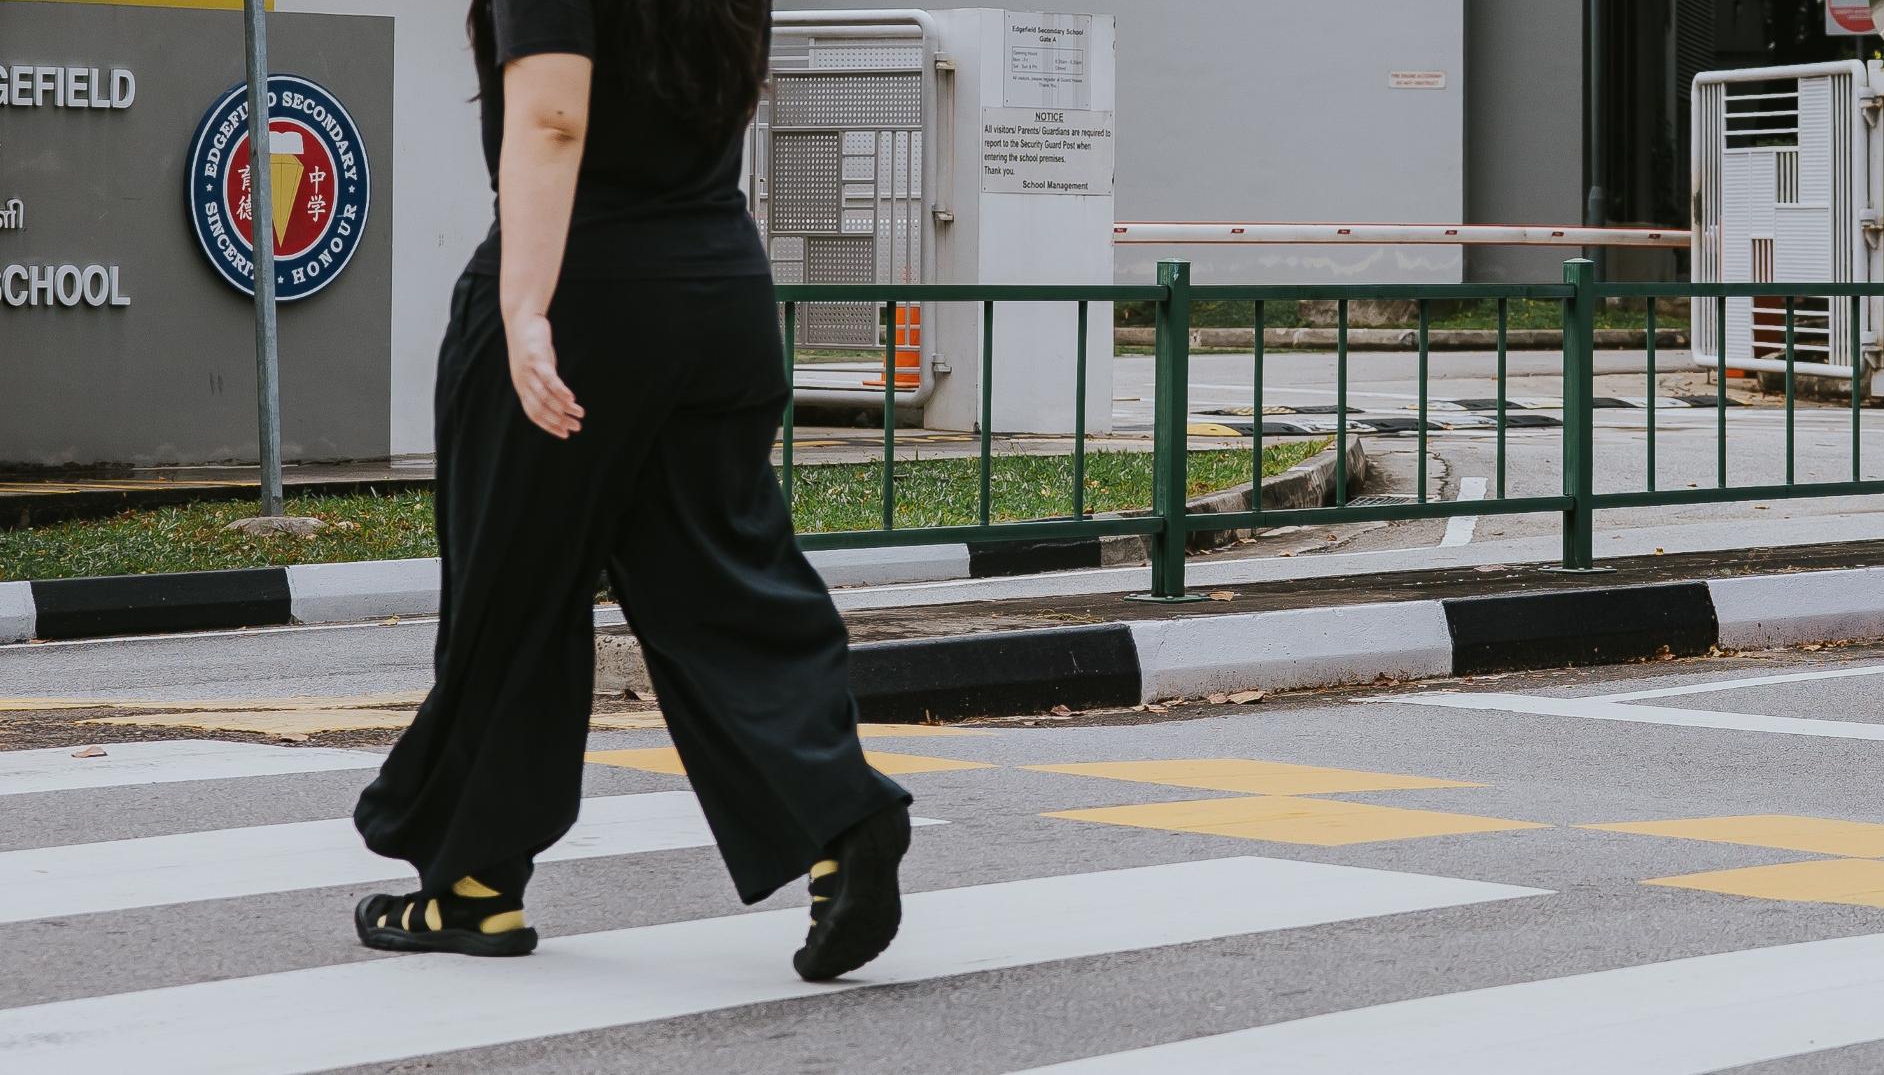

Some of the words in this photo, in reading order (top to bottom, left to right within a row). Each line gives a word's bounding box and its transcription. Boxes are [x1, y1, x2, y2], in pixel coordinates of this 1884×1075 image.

[1038, 27, 1065, 36] Secondary
[1066, 28, 1084, 36] School
[1035, 112, 1064, 122] NOTICE
[282, 91, 358, 181] SECONDARY
[984, 125, 993, 133] All
[1042, 127, 1070, 136] Guardians
[1072, 129, 1080, 137] are
[1082, 128, 1105, 138] required
[1106, 129, 1112, 137] to
[984, 140, 1002, 149] report
[1003, 140, 1009, 148] to
[1010, 139, 1019, 148] the
[1020, 139, 1043, 150] Security
[1045, 140, 1062, 149] Guard
[1063, 141, 1076, 149] Post
[1077, 142, 1091, 150] when
[984, 152, 1008, 163] entering
[1009, 153, 1018, 162] the
[1019, 153, 1038, 162] school
[1039, 154, 1066, 164] premises.
[984, 166, 1001, 175] Thank
[1022, 180, 1045, 189] School
[1047, 180, 1088, 191] Management
[307, 165, 327, 223] 中学
[291, 203, 358, 285] HONOUR
[0, 264, 131, 307] CHOOL
